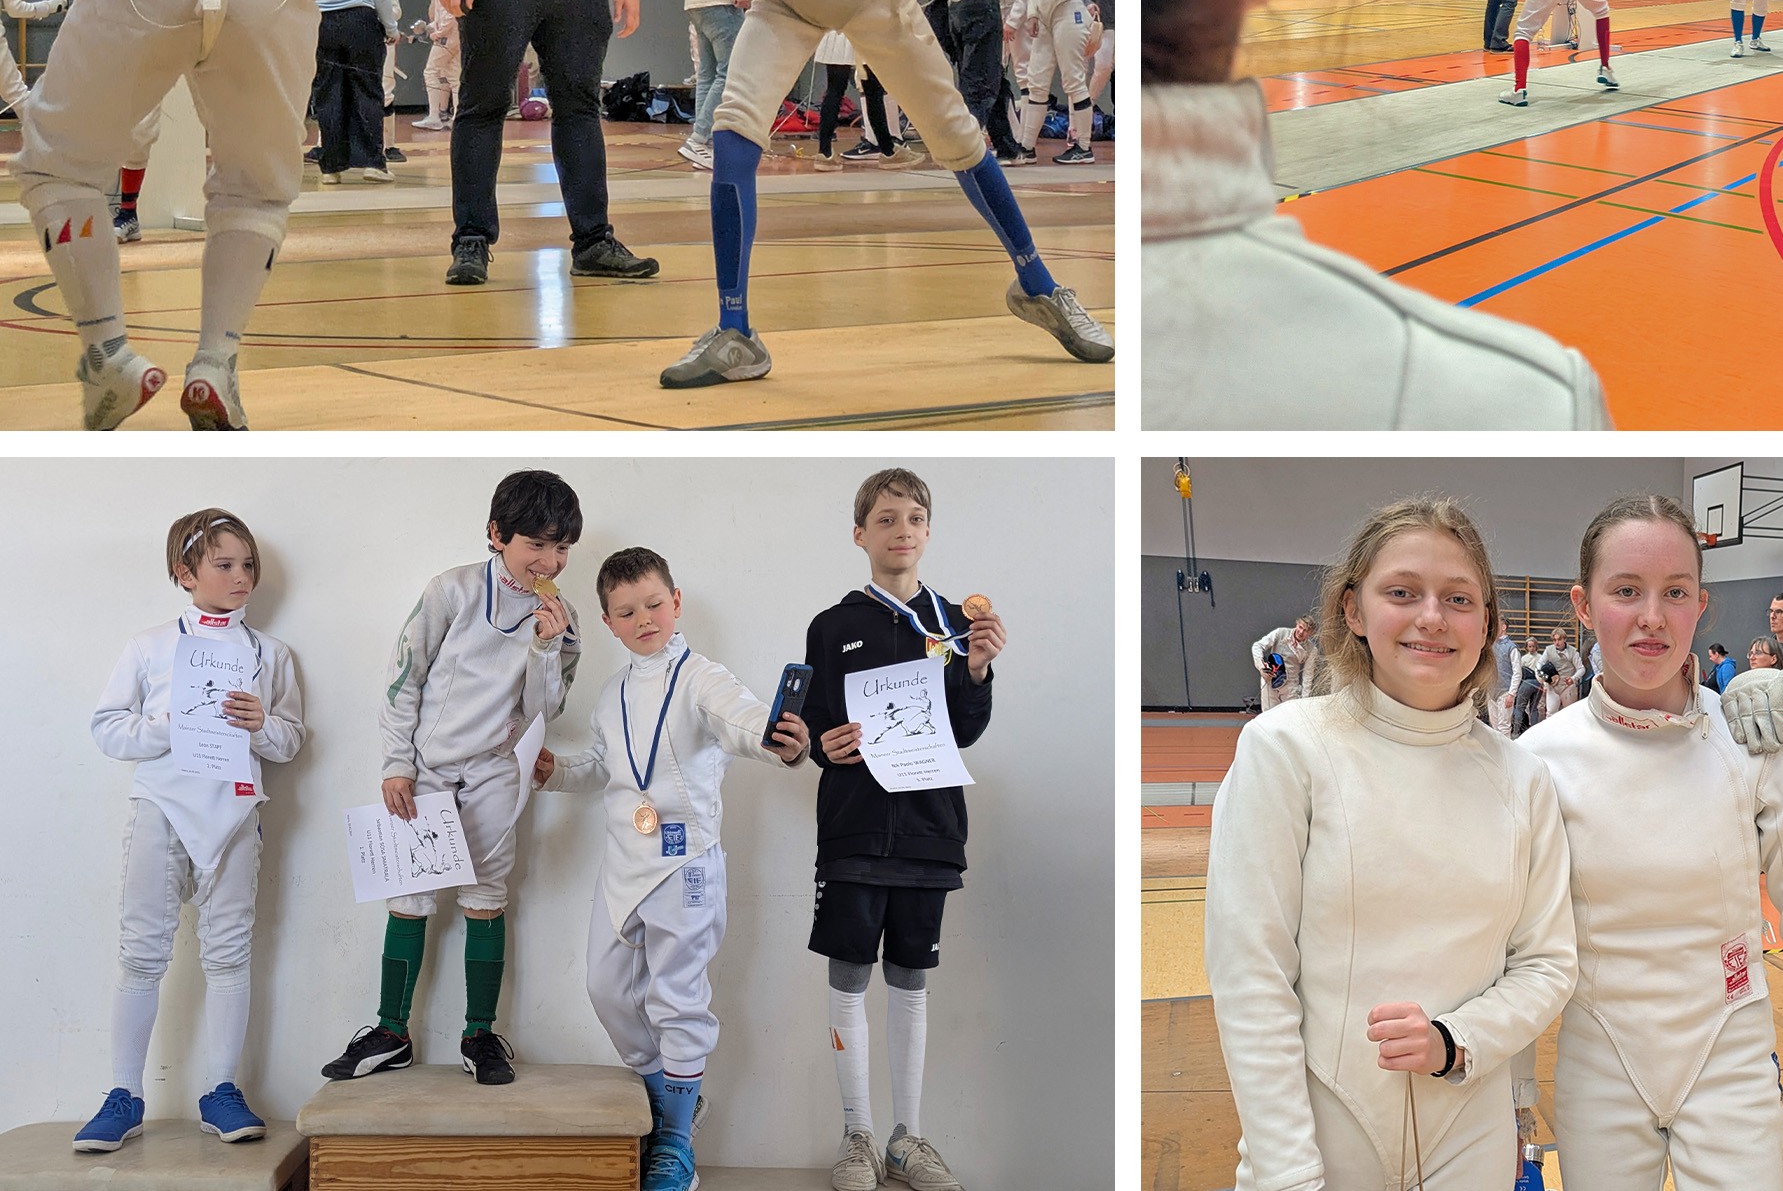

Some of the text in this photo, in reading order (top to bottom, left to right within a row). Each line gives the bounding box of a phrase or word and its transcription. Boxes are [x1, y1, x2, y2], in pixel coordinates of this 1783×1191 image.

[725, 294, 742, 305] Paul
[841, 640, 863, 653] JAKO
[190, 649, 244, 674] Urkunde
[863, 671, 928, 697] Urkunde
[440, 809, 464, 870] Urkunde
[664, 1084, 694, 1095] CITY
